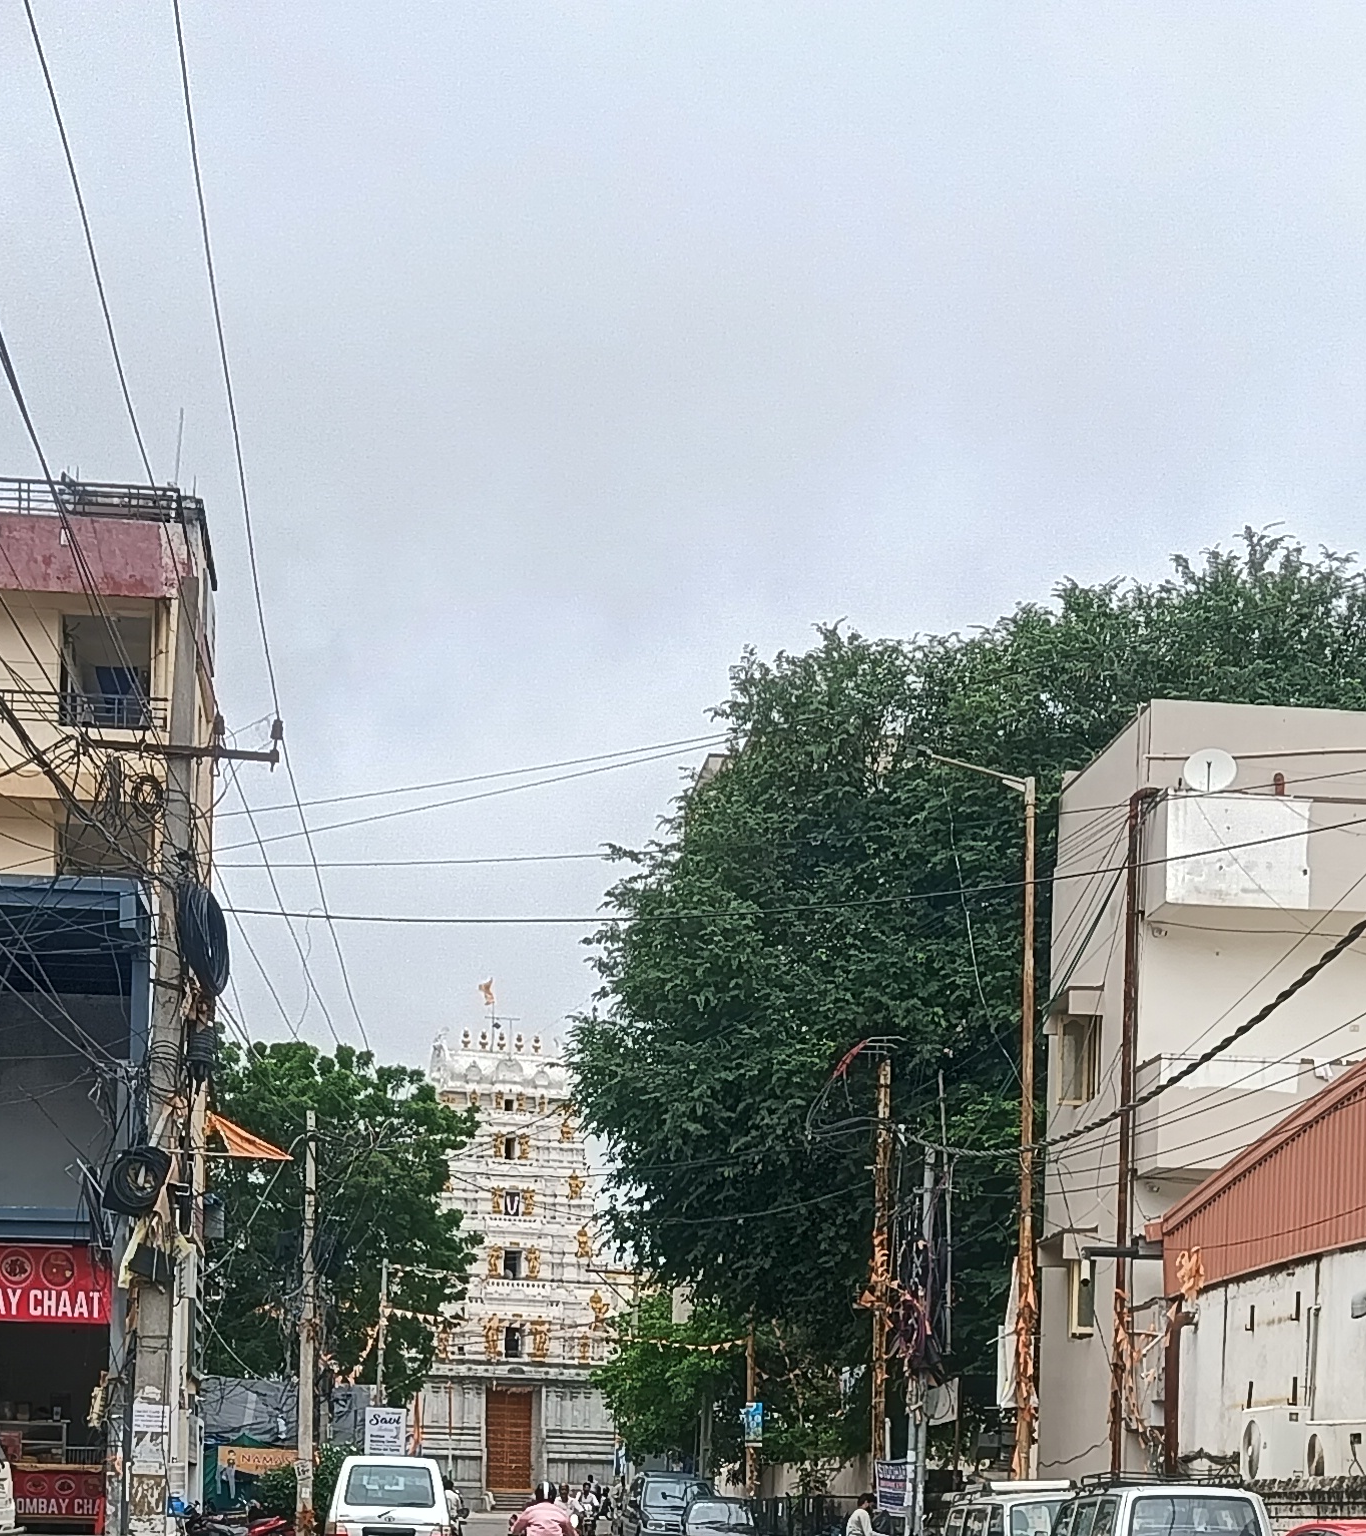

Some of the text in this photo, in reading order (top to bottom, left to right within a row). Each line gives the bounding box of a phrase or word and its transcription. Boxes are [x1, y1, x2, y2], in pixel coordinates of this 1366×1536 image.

[29, 1289, 103, 1319] CHAAT
[241, 1453, 292, 1465] NAMAS
[16, 1497, 101, 1515] OMBAY CHA
